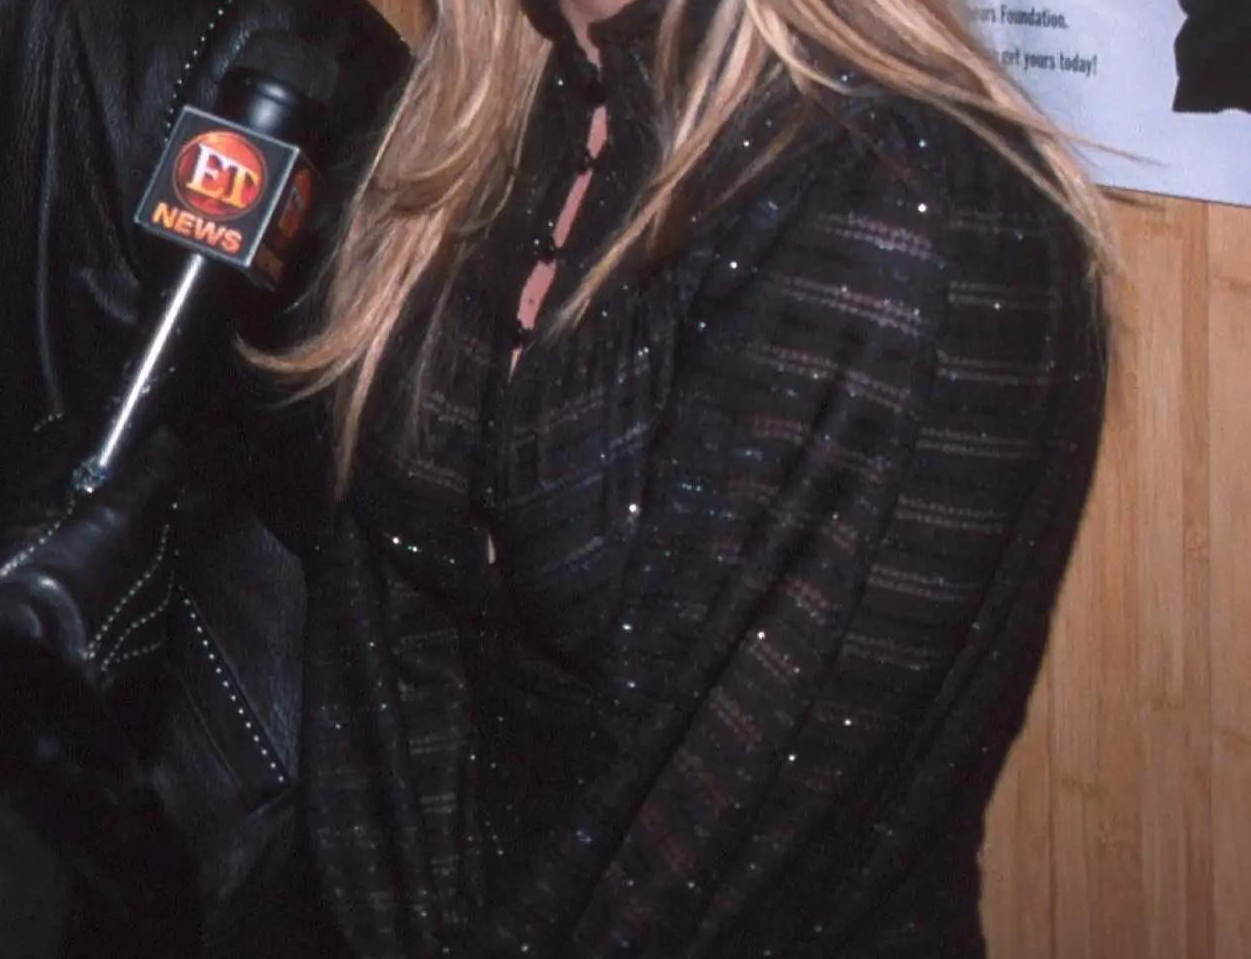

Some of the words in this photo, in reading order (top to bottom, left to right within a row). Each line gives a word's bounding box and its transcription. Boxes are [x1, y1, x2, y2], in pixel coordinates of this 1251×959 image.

[1000, 4, 1069, 29] Foundation.
[1024, 53, 1056, 73] yours
[1059, 52, 1097, 78] today!
[186, 143, 260, 210] ET
[152, 201, 243, 254] NEWS
